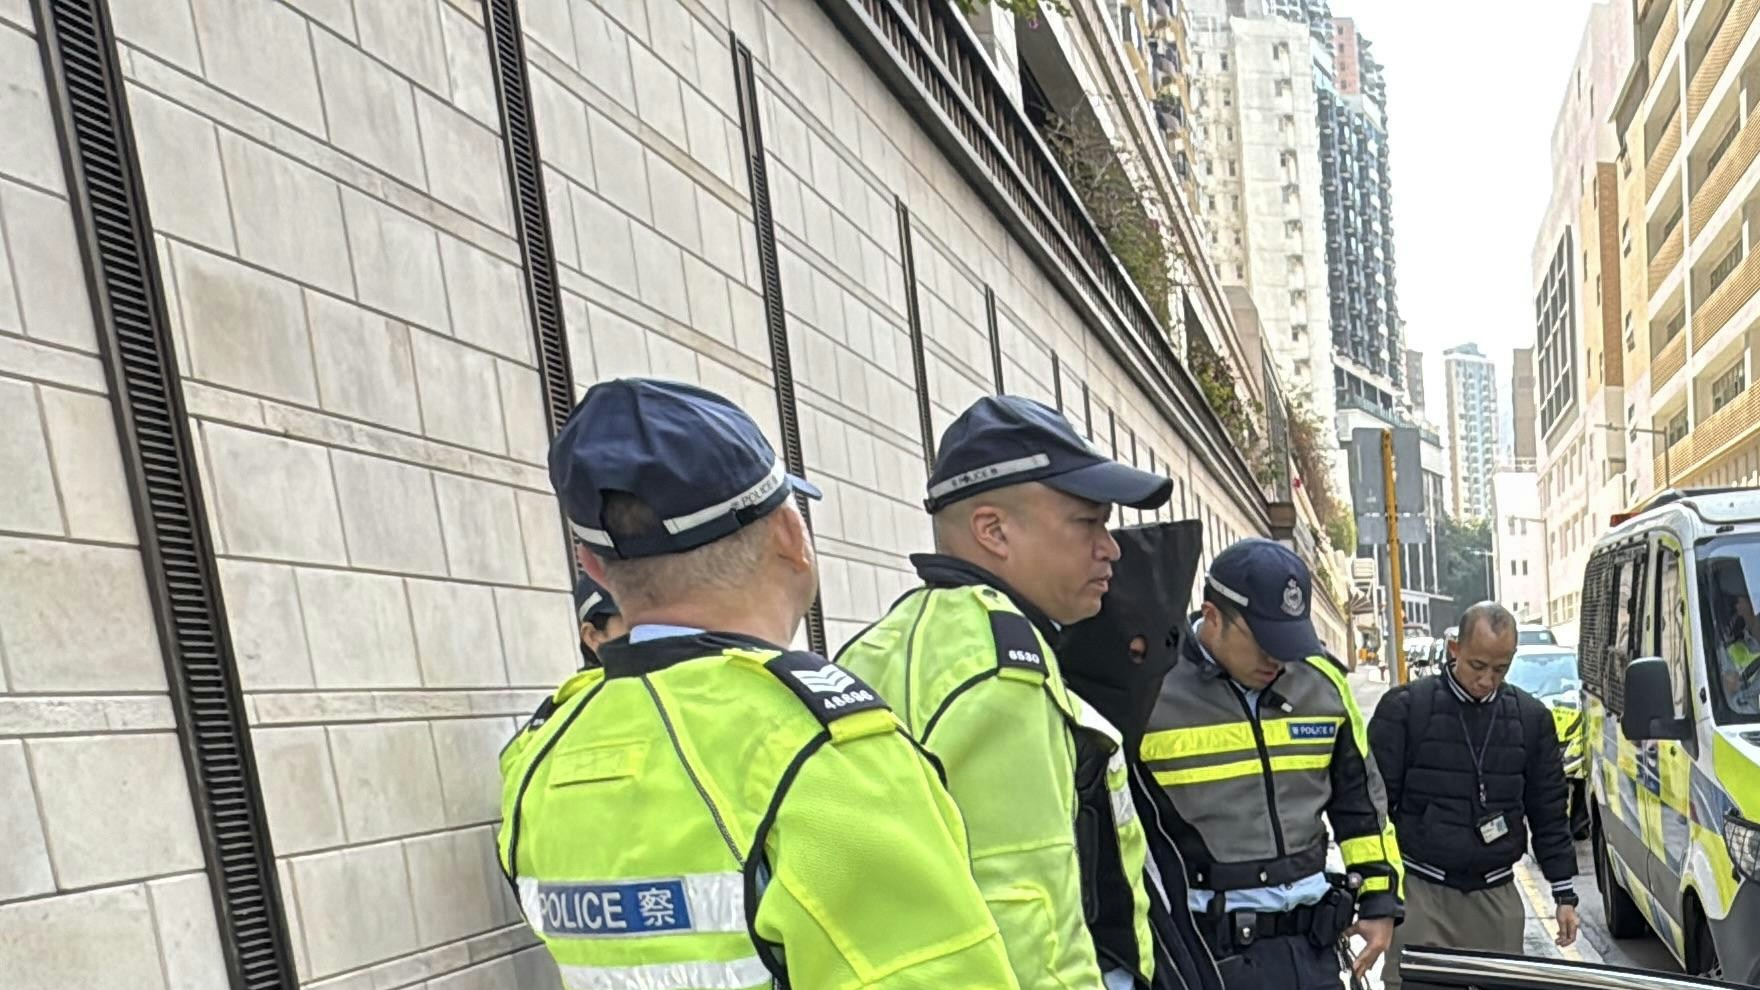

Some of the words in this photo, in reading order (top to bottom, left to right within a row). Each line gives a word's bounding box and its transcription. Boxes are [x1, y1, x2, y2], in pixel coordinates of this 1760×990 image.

[1300, 725, 1328, 735] POLICE
[538, 891, 628, 929] POLICE
[637, 887, 676, 928] 察
